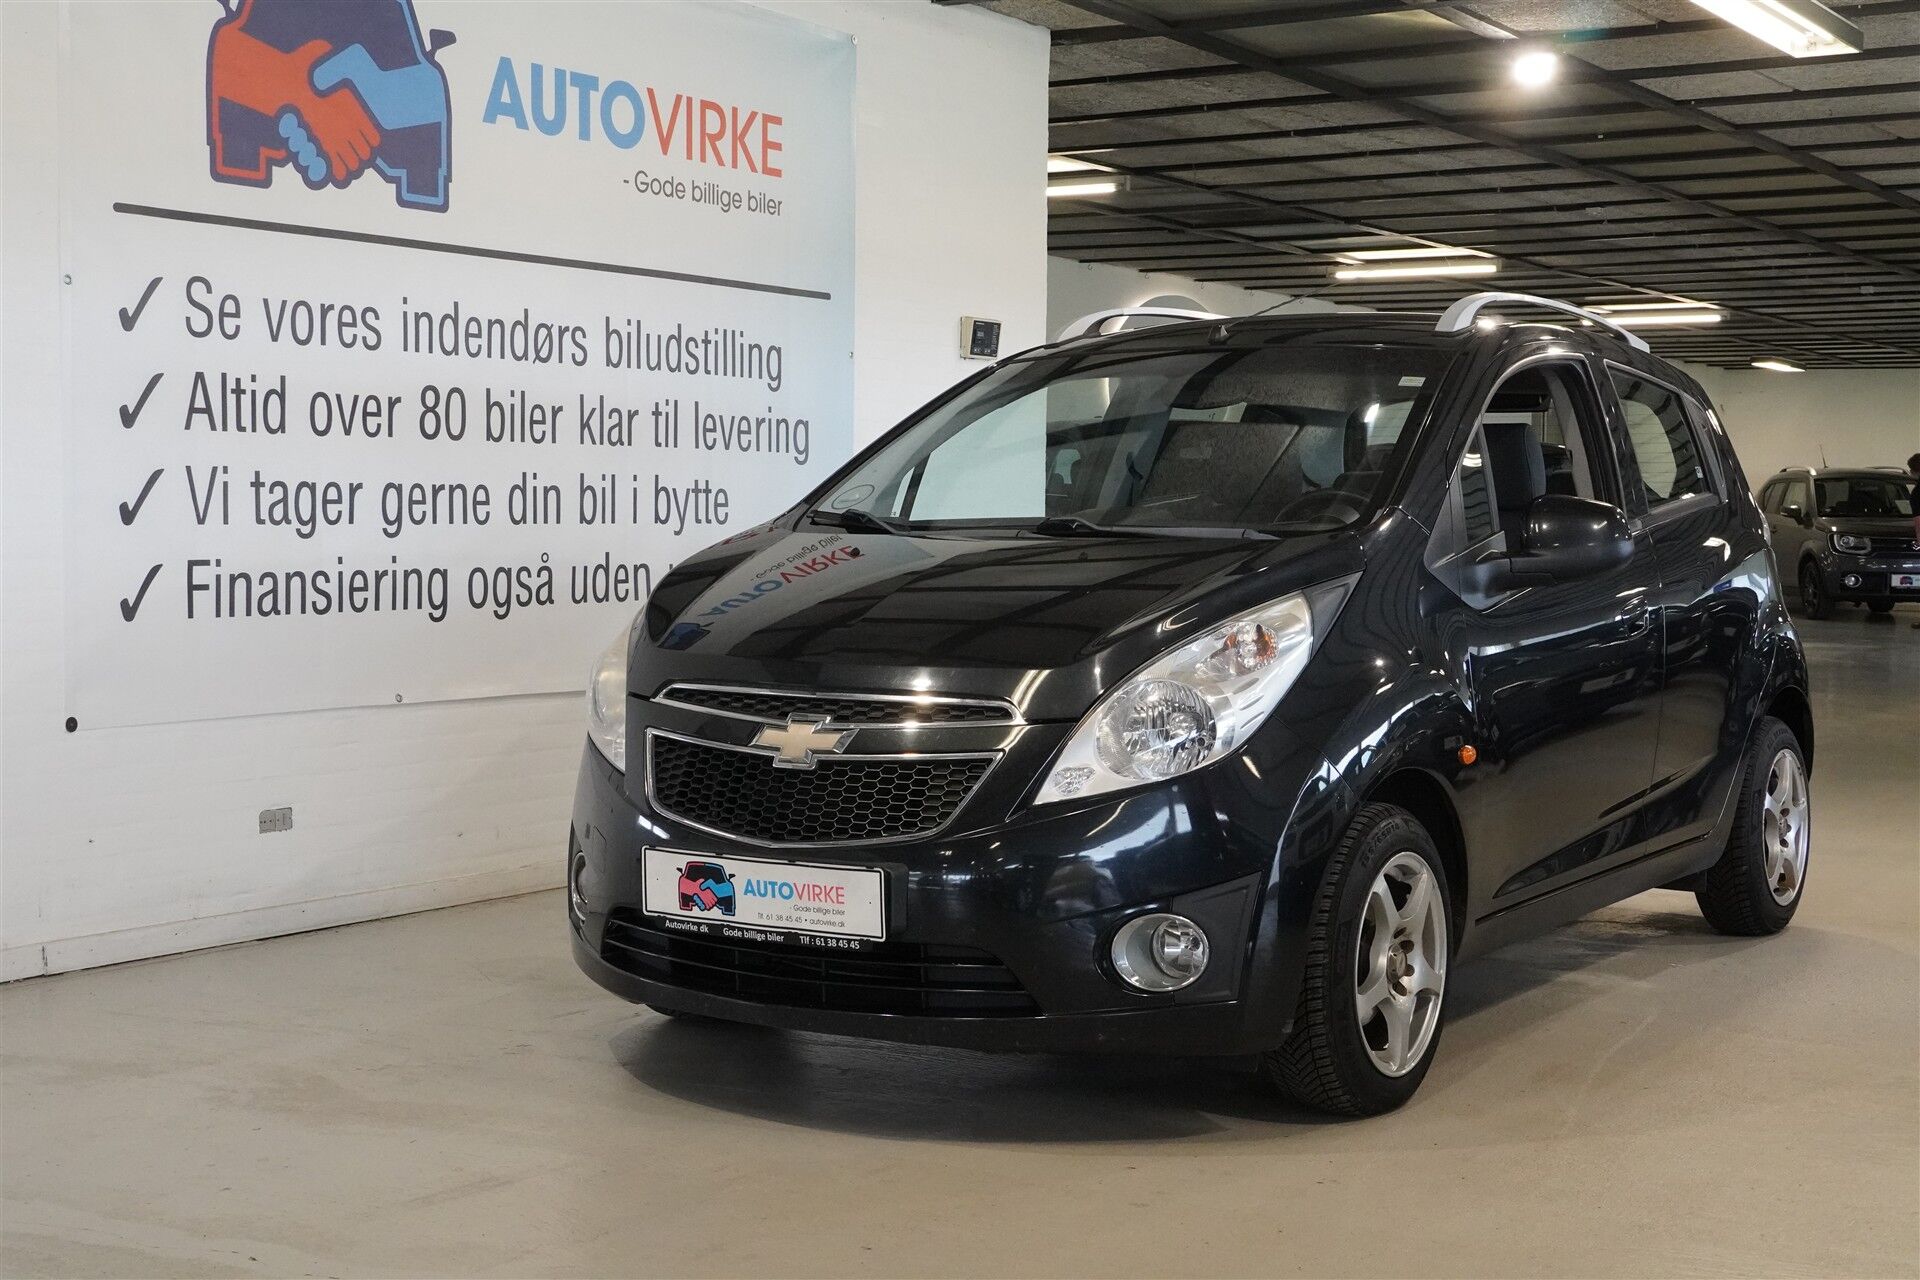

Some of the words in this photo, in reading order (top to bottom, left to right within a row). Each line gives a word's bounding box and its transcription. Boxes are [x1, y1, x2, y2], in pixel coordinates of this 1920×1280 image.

[483, 56, 784, 179] AUTOVIRKE
[634, 169, 686, 200] Gode
[691, 179, 743, 214] billige
[747, 189, 783, 217] biler
[184, 275, 242, 341] Se
[262, 297, 382, 352] vores
[402, 296, 588, 368] indendørs
[605, 315, 782, 393] biludstilling
[183, 371, 287, 436] Altid
[309, 391, 402, 439] over
[418, 384, 467, 442] 80
[485, 387, 564, 446] biler
[579, 393, 640, 448] klar
[651, 399, 679, 450] til
[694, 400, 810, 466] levering
[184, 465, 230, 528] Vi
[249, 470, 364, 540] tager
[381, 481, 491, 542] gerne
[508, 471, 562, 527] din
[579, 472, 616, 527] bil
[632, 474, 639, 526] i
[653, 474, 729, 538] bytte
[186, 555, 449, 621] Finansiering
[467, 551, 555, 621] også
[570, 551, 651, 609] uden
[743, 878, 845, 905] AUTOVIRKE
[765, 913, 774, 921] 61
[775, 914, 784, 922] 38
[785, 915, 793, 923] 45
[794, 916, 803, 924] 45
[793, 904, 812, 913] Gode
[832, 908, 846, 916] biler
[665, 919, 698, 932] Autovirke
[723, 927, 743, 938] Gode
[743, 930, 766, 941] billige
[766, 932, 785, 943] biler
[815, 937, 826, 946] 61
[826, 938, 837, 948] 38
[838, 939, 849, 949] 45
[849, 940, 860, 950] 45
